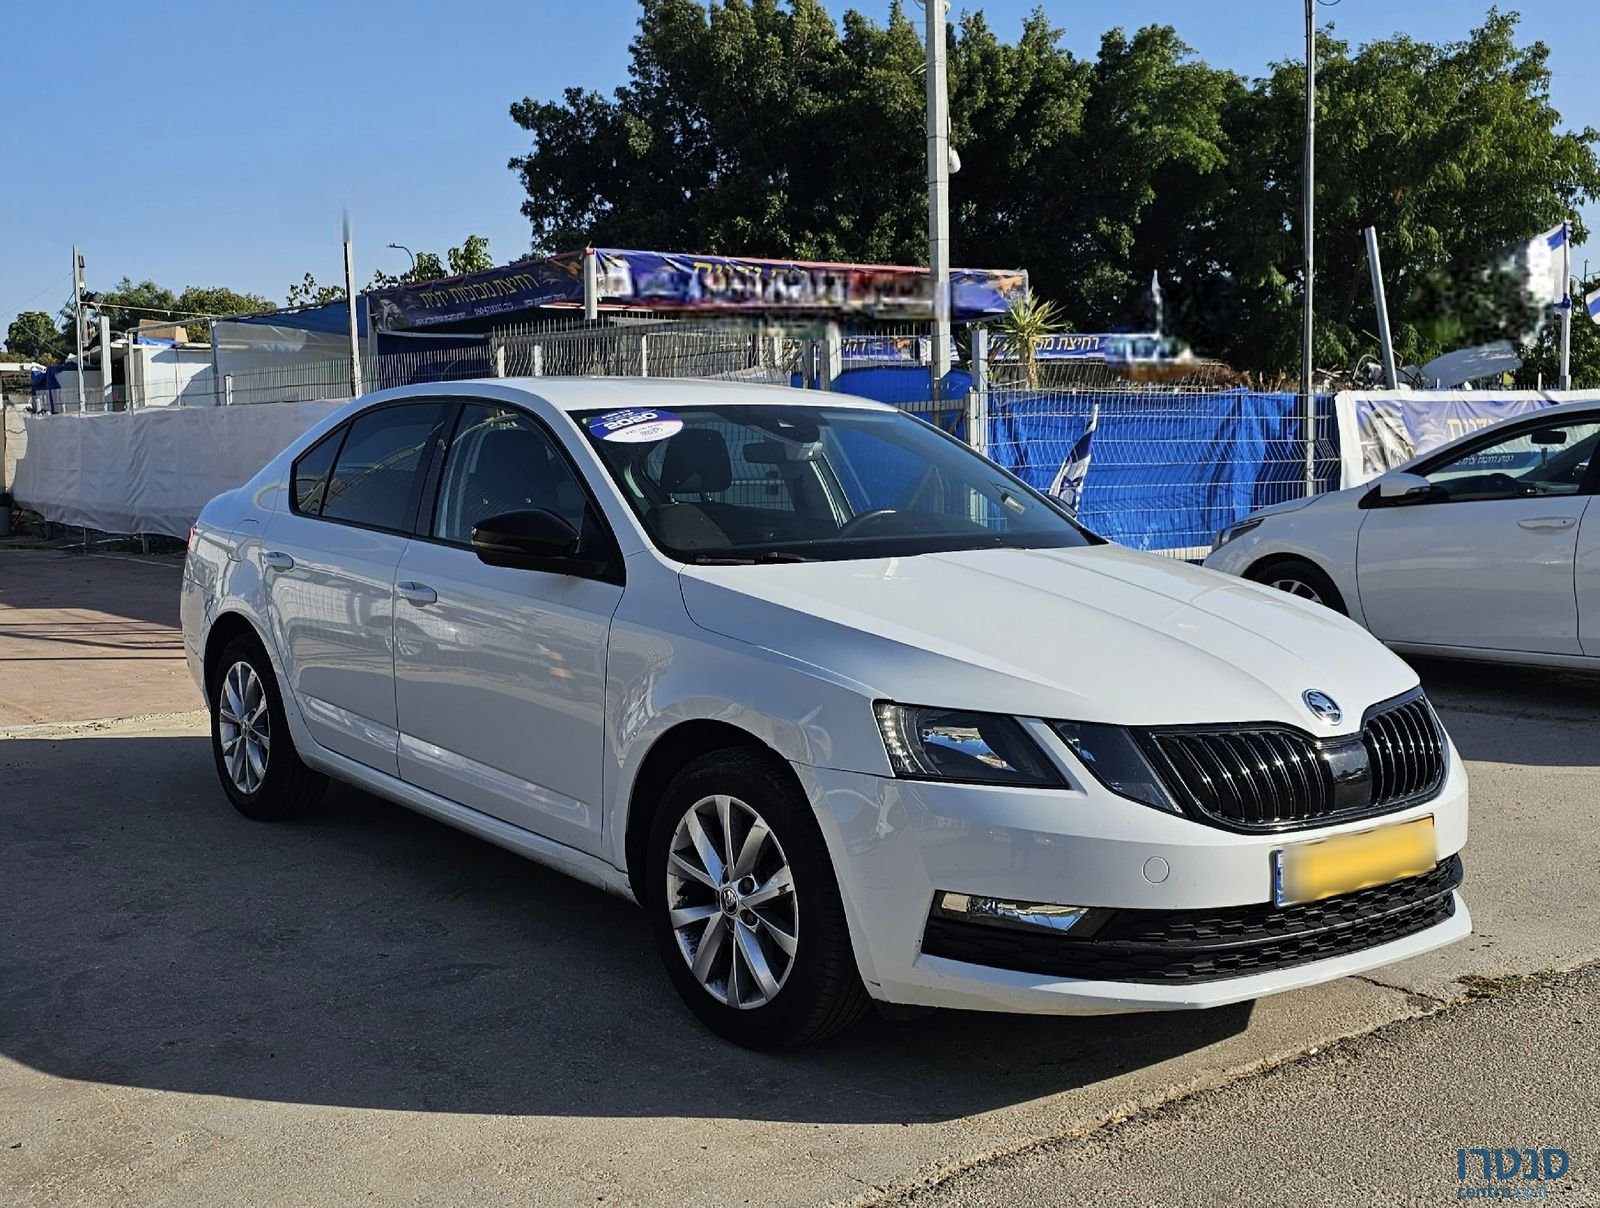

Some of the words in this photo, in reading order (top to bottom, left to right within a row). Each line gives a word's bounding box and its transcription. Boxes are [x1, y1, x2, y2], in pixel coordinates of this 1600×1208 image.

[449, 283, 497, 303] מכוניות
[493, 274, 539, 296] רחיצת
[419, 291, 448, 308] ידנית
[1056, 336, 1100, 351] רחיצת
[604, 413, 658, 430] 2020
